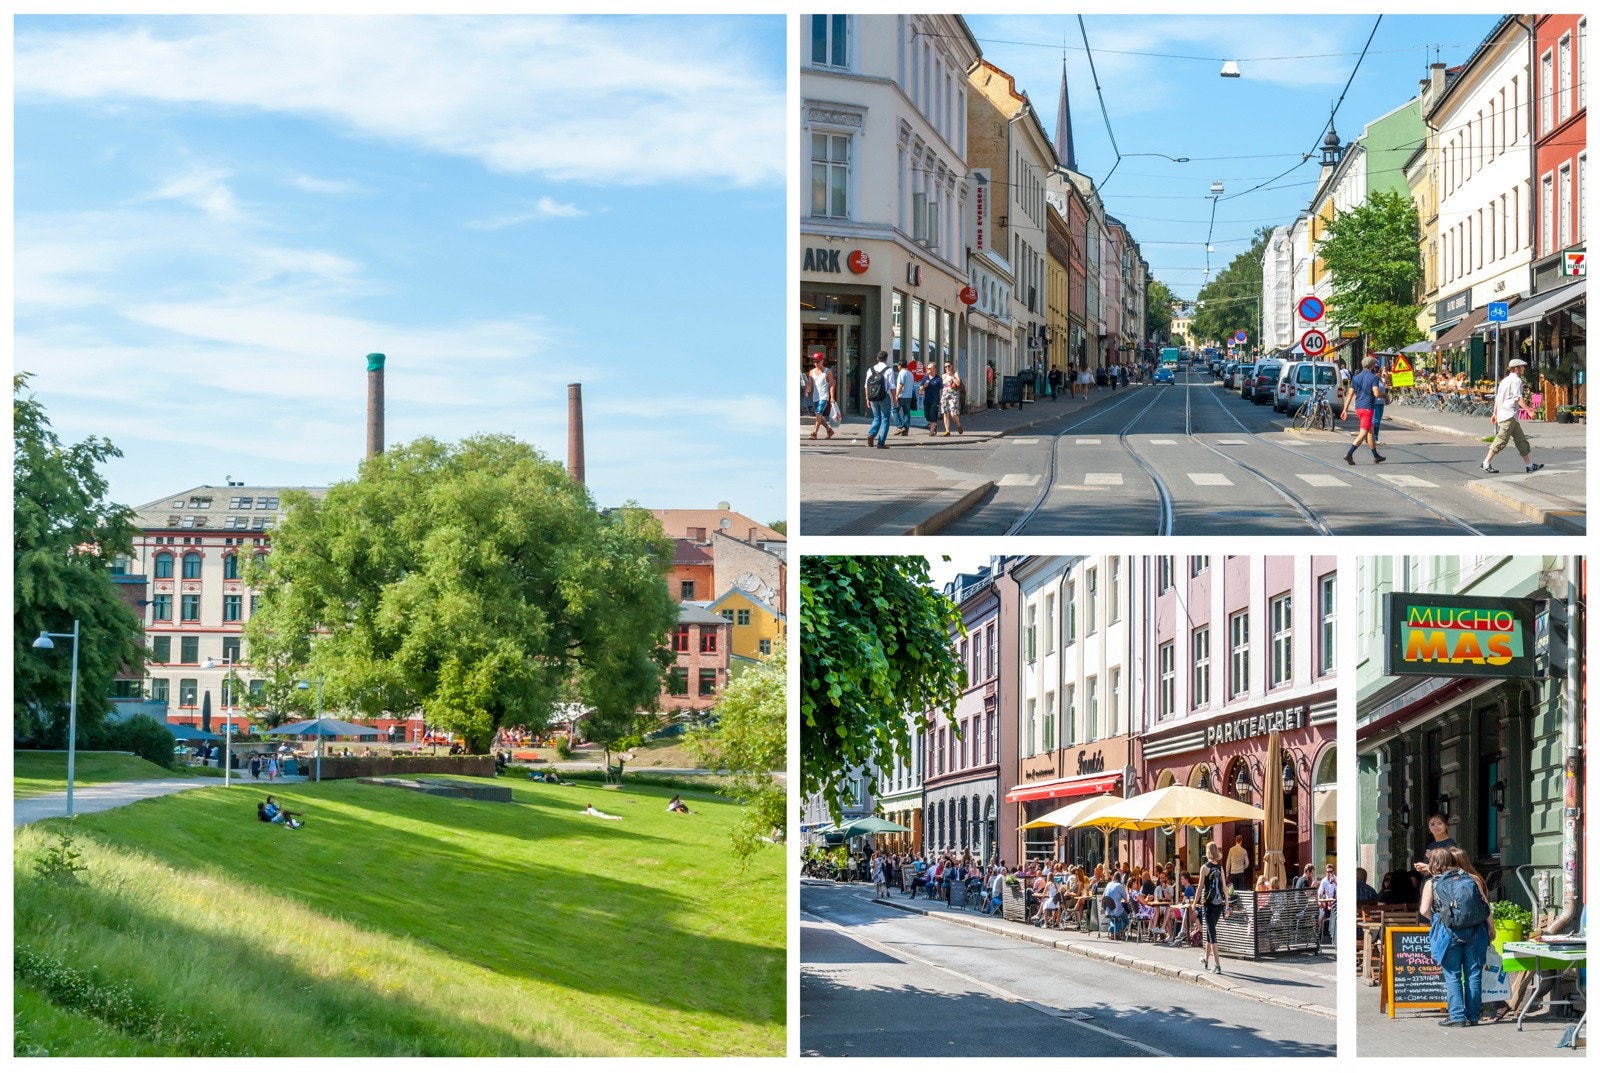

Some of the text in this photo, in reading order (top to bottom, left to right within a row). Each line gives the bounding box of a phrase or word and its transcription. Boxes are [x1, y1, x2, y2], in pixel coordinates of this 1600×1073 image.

[803, 247, 842, 274] ARK
[1568, 254, 1584, 276] 7
[1306, 336, 1323, 349] 40
[1408, 607, 1513, 631] MUCHO
[1405, 629, 1513, 666] MAS
[1207, 705, 1305, 746] PARKTEATRET
